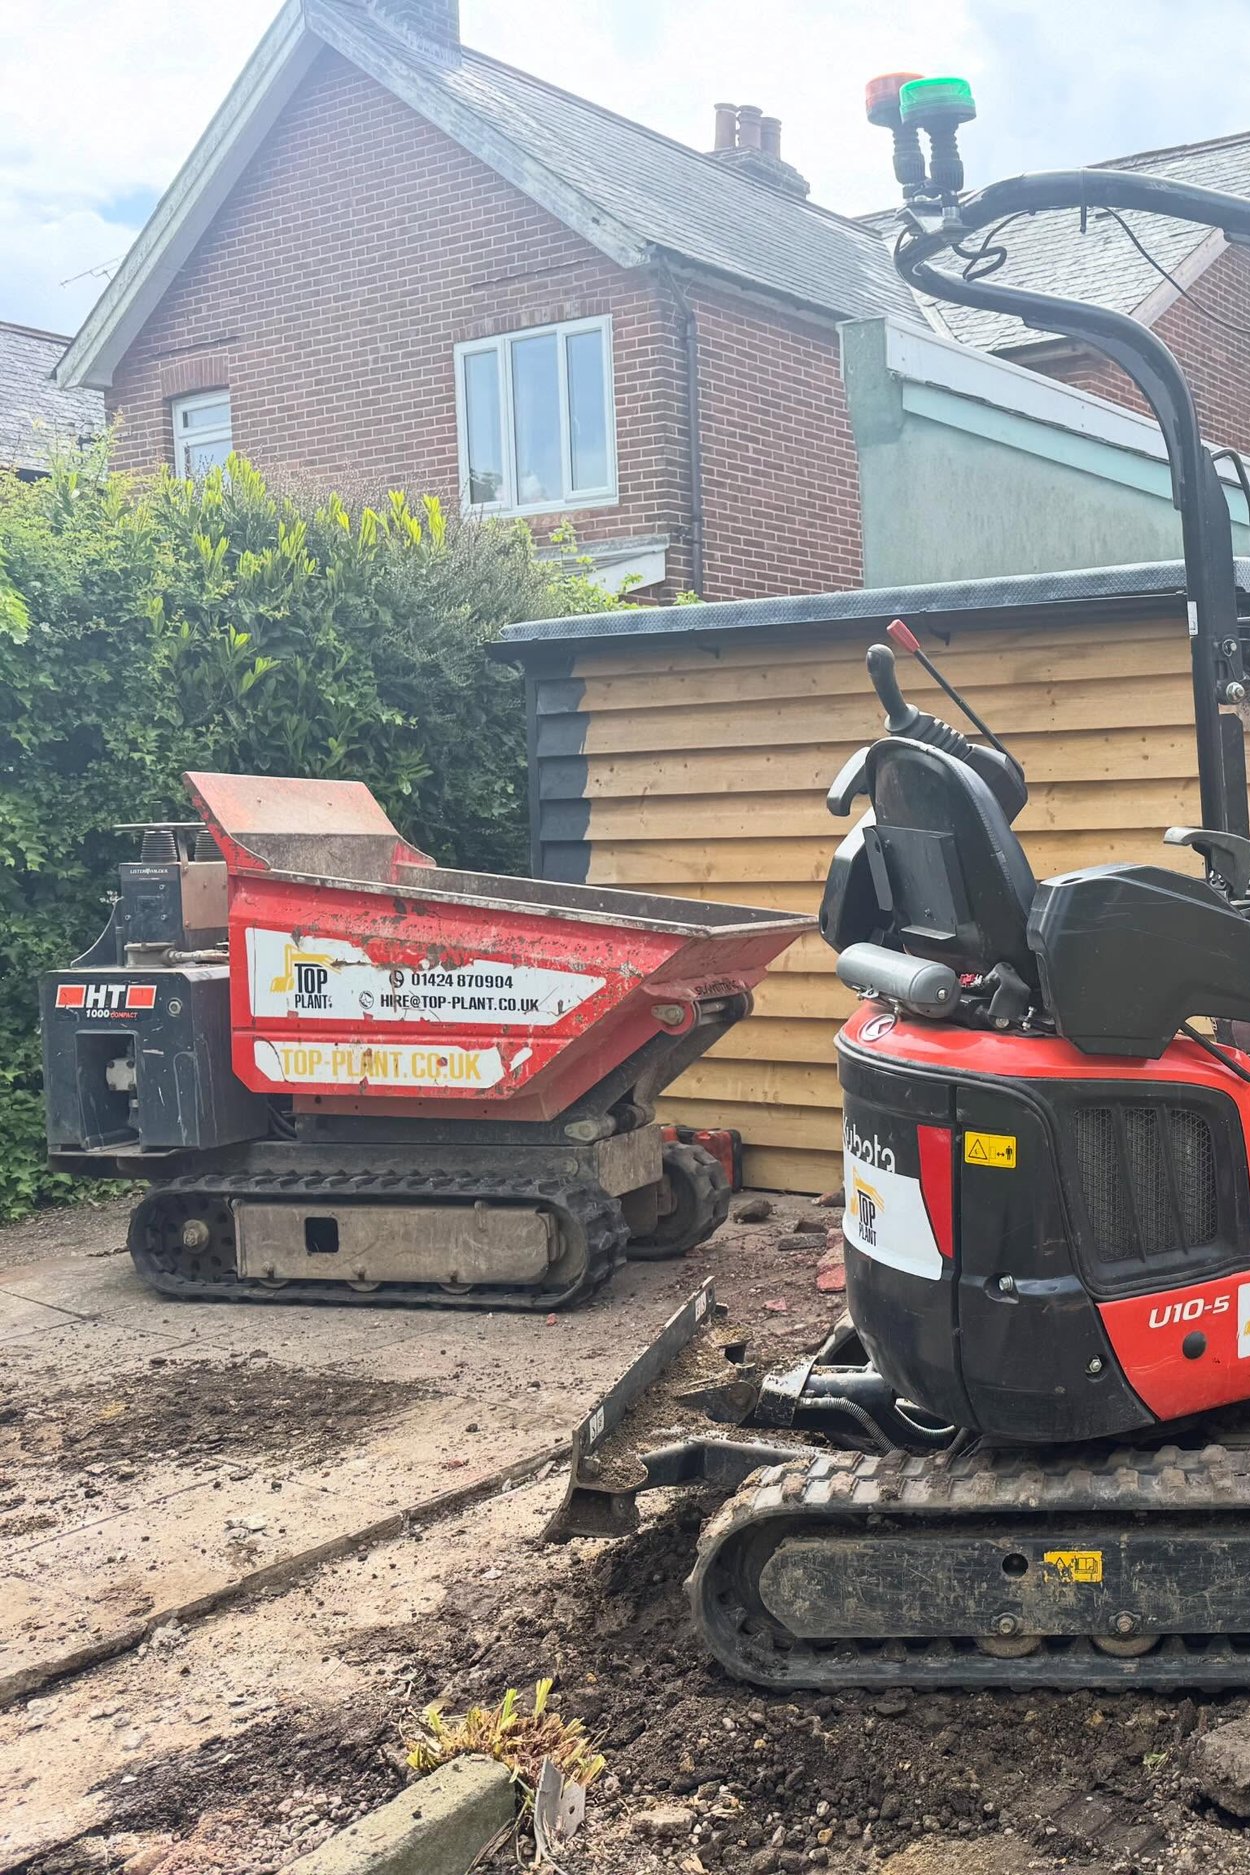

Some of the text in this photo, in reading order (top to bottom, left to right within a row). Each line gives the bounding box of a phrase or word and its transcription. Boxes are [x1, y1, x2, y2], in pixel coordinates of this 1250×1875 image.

[294, 963, 328, 993] TOP
[411, 973, 514, 989] 01424 870904
[85, 984, 126, 1009] HT
[294, 994, 328, 1009] PLANT
[381, 994, 539, 1013] HIRE@TOP-PLANT.CO.UK
[86, 1009, 138, 1019] 1000 COMPACT
[857, 1189, 876, 1229] TOP
[858, 1222, 877, 1246] PLANT
[1149, 1295, 1231, 1329] U10-5
